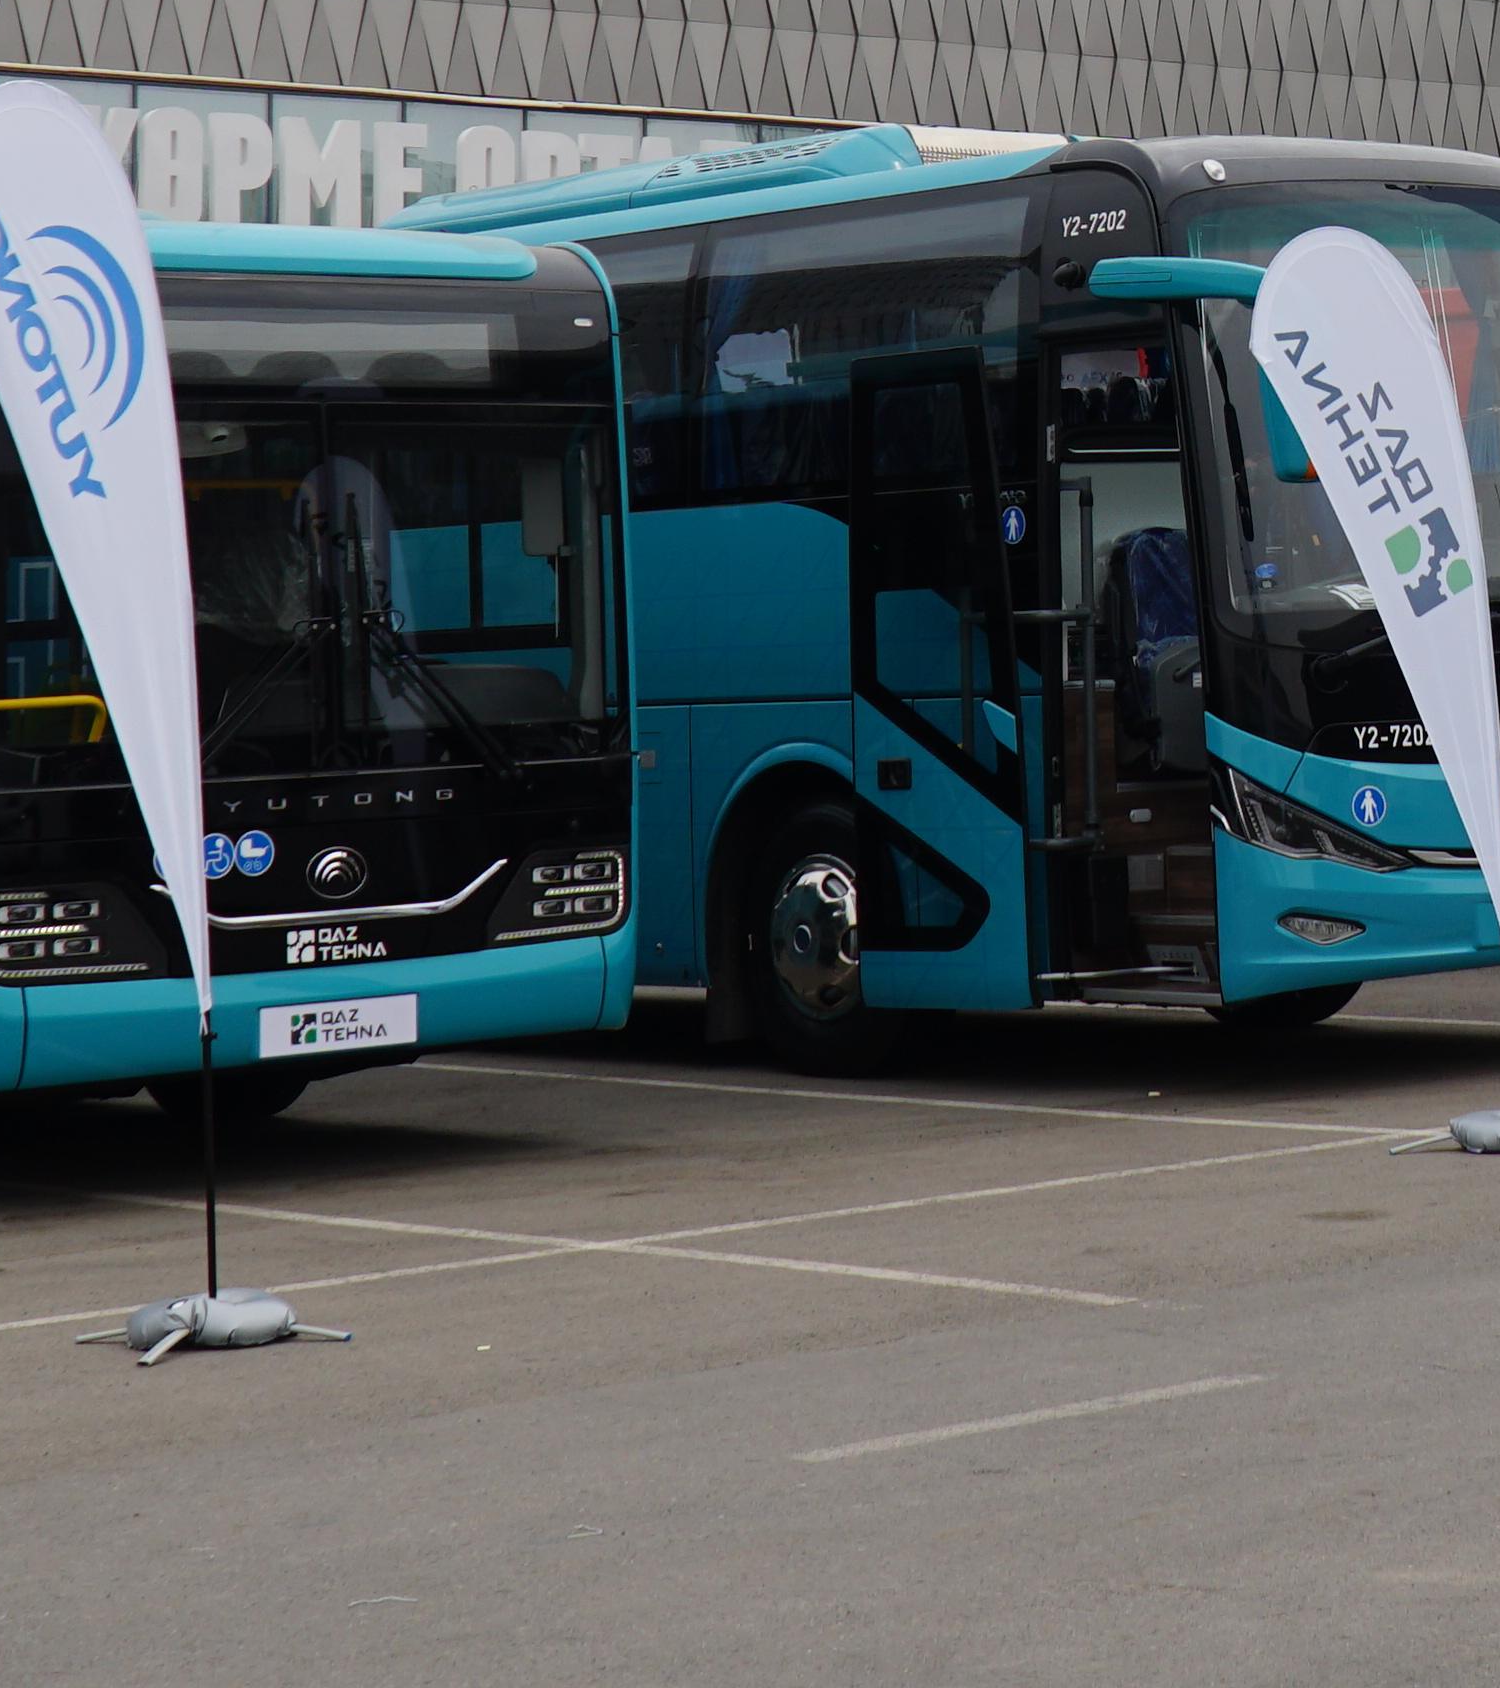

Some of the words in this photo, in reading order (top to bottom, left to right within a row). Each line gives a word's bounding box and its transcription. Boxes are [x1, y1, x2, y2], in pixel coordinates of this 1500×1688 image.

[1062, 209, 1127, 238] Y2-7202
[223, 788, 453, 812] YUTONG
[318, 925, 359, 944] QAZ
[318, 941, 388, 962] TEHNA
[321, 1008, 360, 1025] QAZ
[321, 1024, 388, 1043] TEHNA
